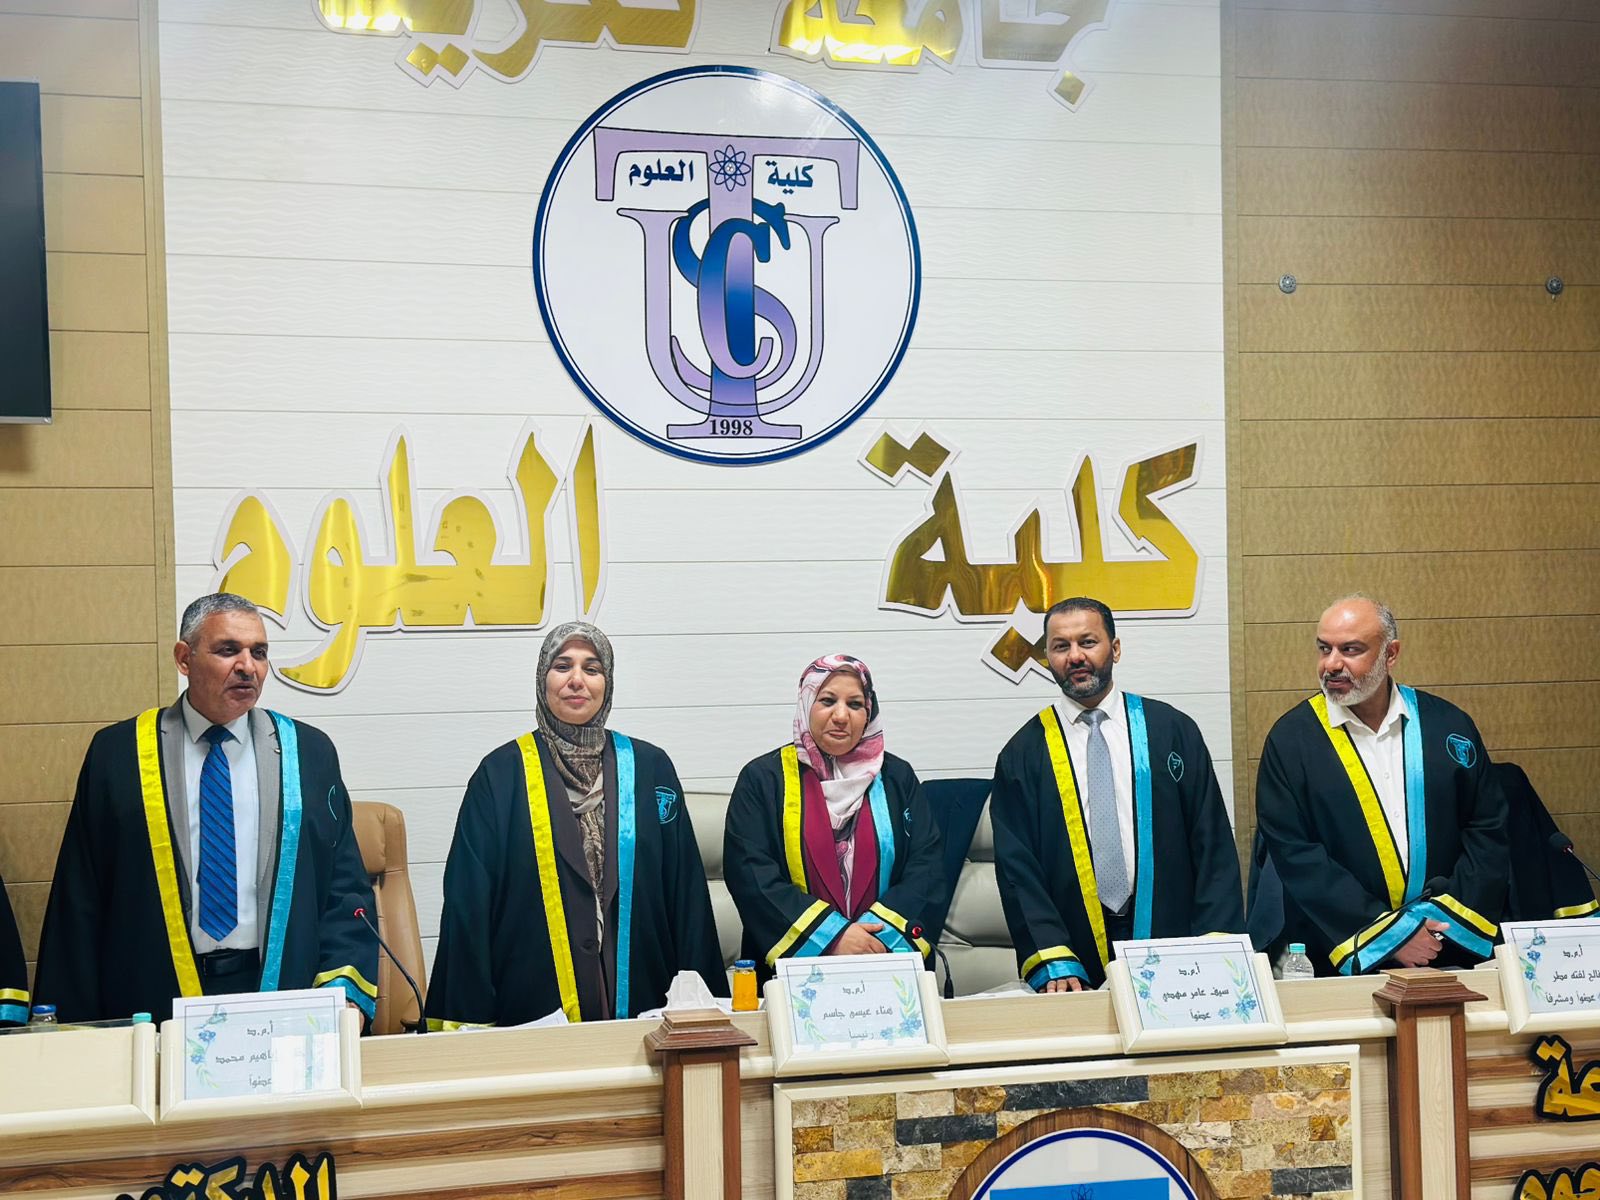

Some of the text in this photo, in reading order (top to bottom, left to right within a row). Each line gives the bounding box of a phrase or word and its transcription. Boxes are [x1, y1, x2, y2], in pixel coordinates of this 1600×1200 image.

[629, 158, 814, 195] كلية العلوم
[709, 418, 753, 436] 1998
[217, 422, 1198, 690] كلية العلوم
[1552, 970, 1568, 982] مطر
[1163, 986, 1229, 1002] سيف عامر مهدي
[823, 1008, 846, 1020] جاسم
[876, 1004, 893, 1016] هناء
[215, 1055, 245, 1065] محمد
